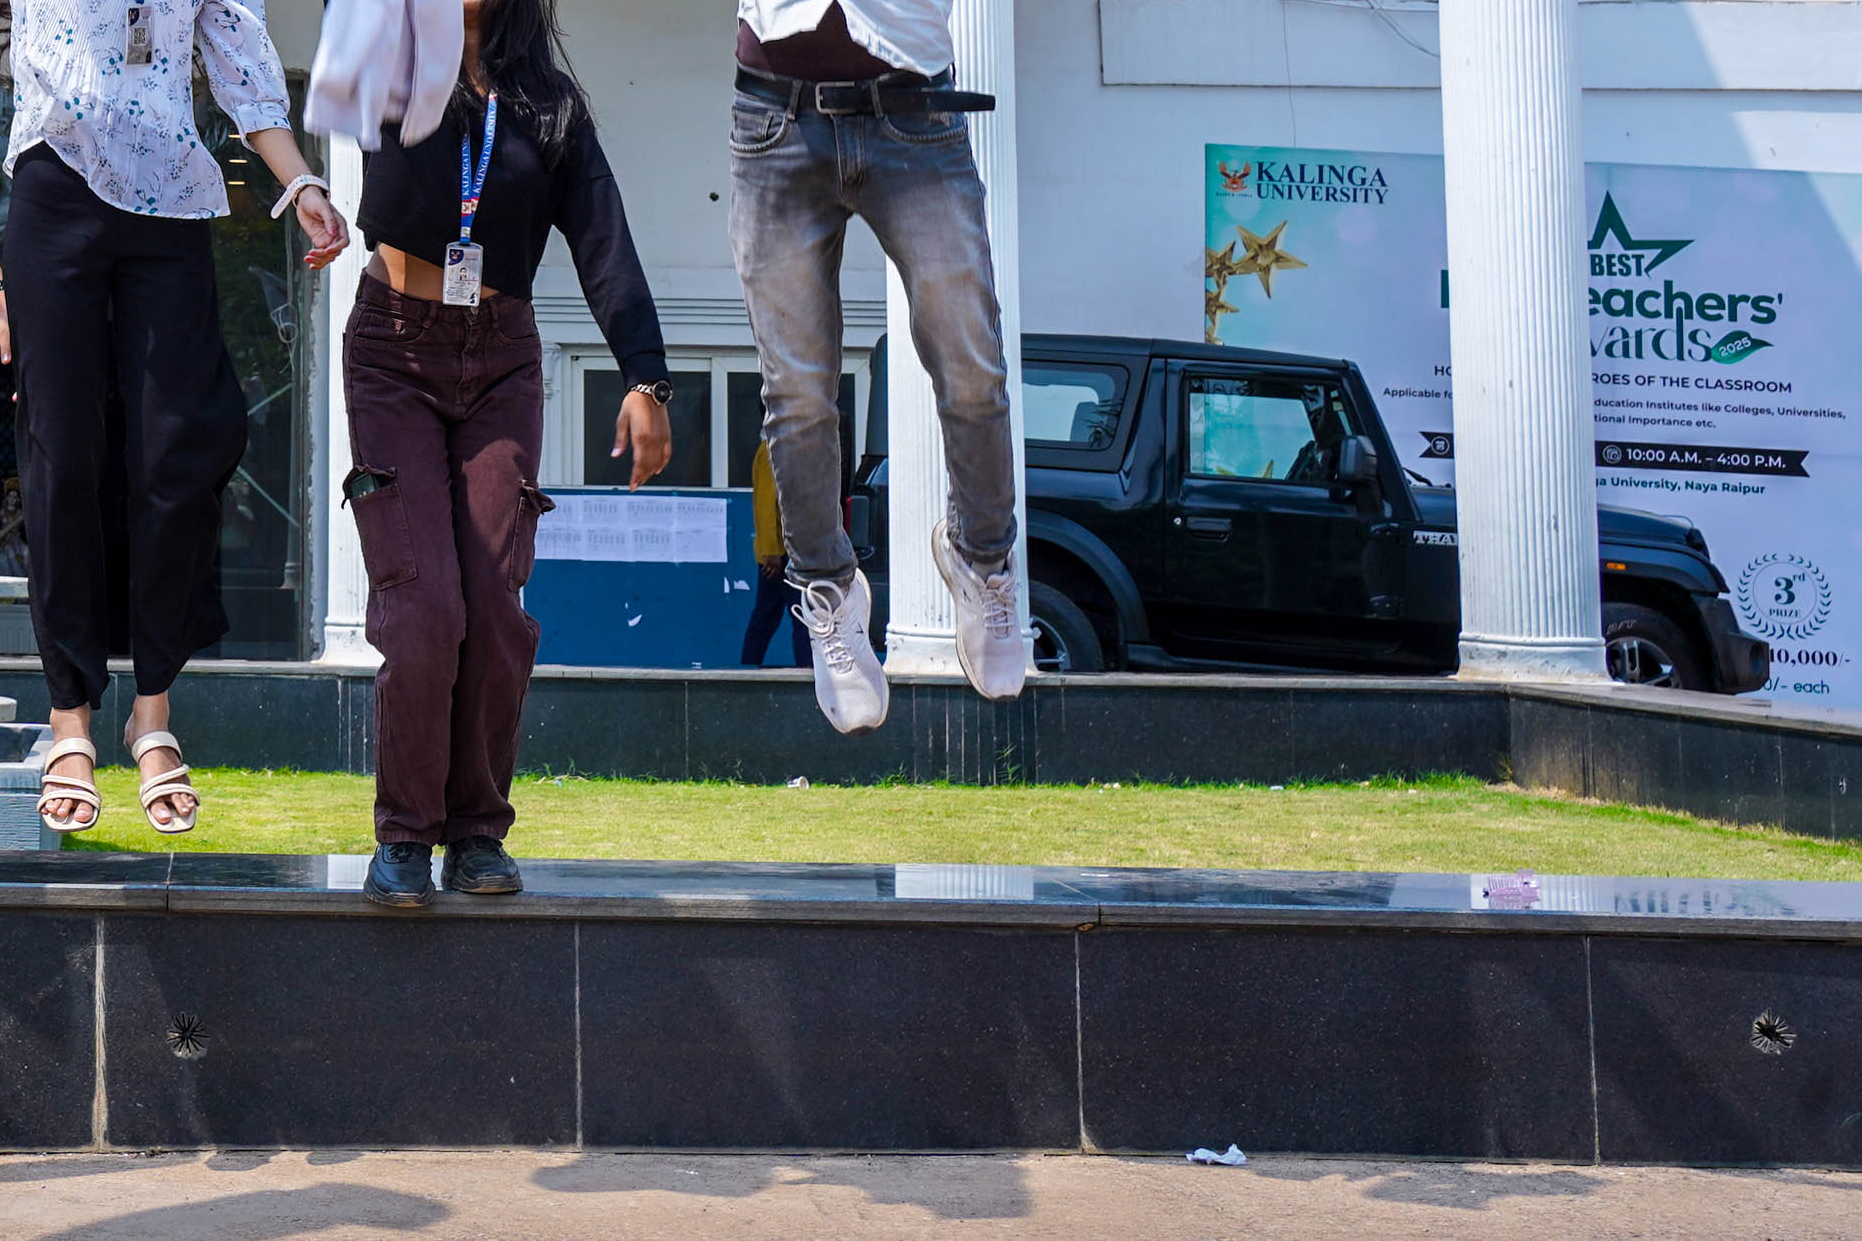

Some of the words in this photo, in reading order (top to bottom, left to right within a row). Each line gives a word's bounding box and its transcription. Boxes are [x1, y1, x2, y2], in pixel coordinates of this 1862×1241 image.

[1256, 161, 1388, 187] KALINGA
[1256, 182, 1389, 205] UNIVERSITY
[1590, 253, 1646, 278] BEST
[1588, 279, 1784, 325] eachers'
[1718, 335, 1753, 359] 2025
[1383, 387, 1441, 399] Applicable
[1592, 373, 1631, 386] ROES
[1634, 374, 1656, 387] OF
[1659, 375, 1691, 389] THE
[1694, 377, 1793, 394] CLASSROOM
[1594, 398, 1644, 409] ducation
[1646, 399, 1699, 411] Institutes
[1701, 401, 1723, 412] like
[1724, 403, 1776, 417] Colleges,
[1777, 406, 1847, 420] Universities,
[1594, 413, 1626, 424] tional
[1628, 414, 1693, 429] Importance
[1695, 417, 1717, 429] etc.
[1626, 447, 1666, 463] 10:00
[1668, 450, 1702, 464] A.M.
[1717, 452, 1751, 466] 4:00
[1754, 454, 1787, 468] P.M.
[1611, 477, 1682, 493] University,
[1684, 480, 1719, 494] Naya
[1721, 481, 1766, 496] Raipur
[1412, 529, 1458, 546] THA
[1768, 608, 1802, 619] PRIZE
[1793, 679, 1830, 695] each
